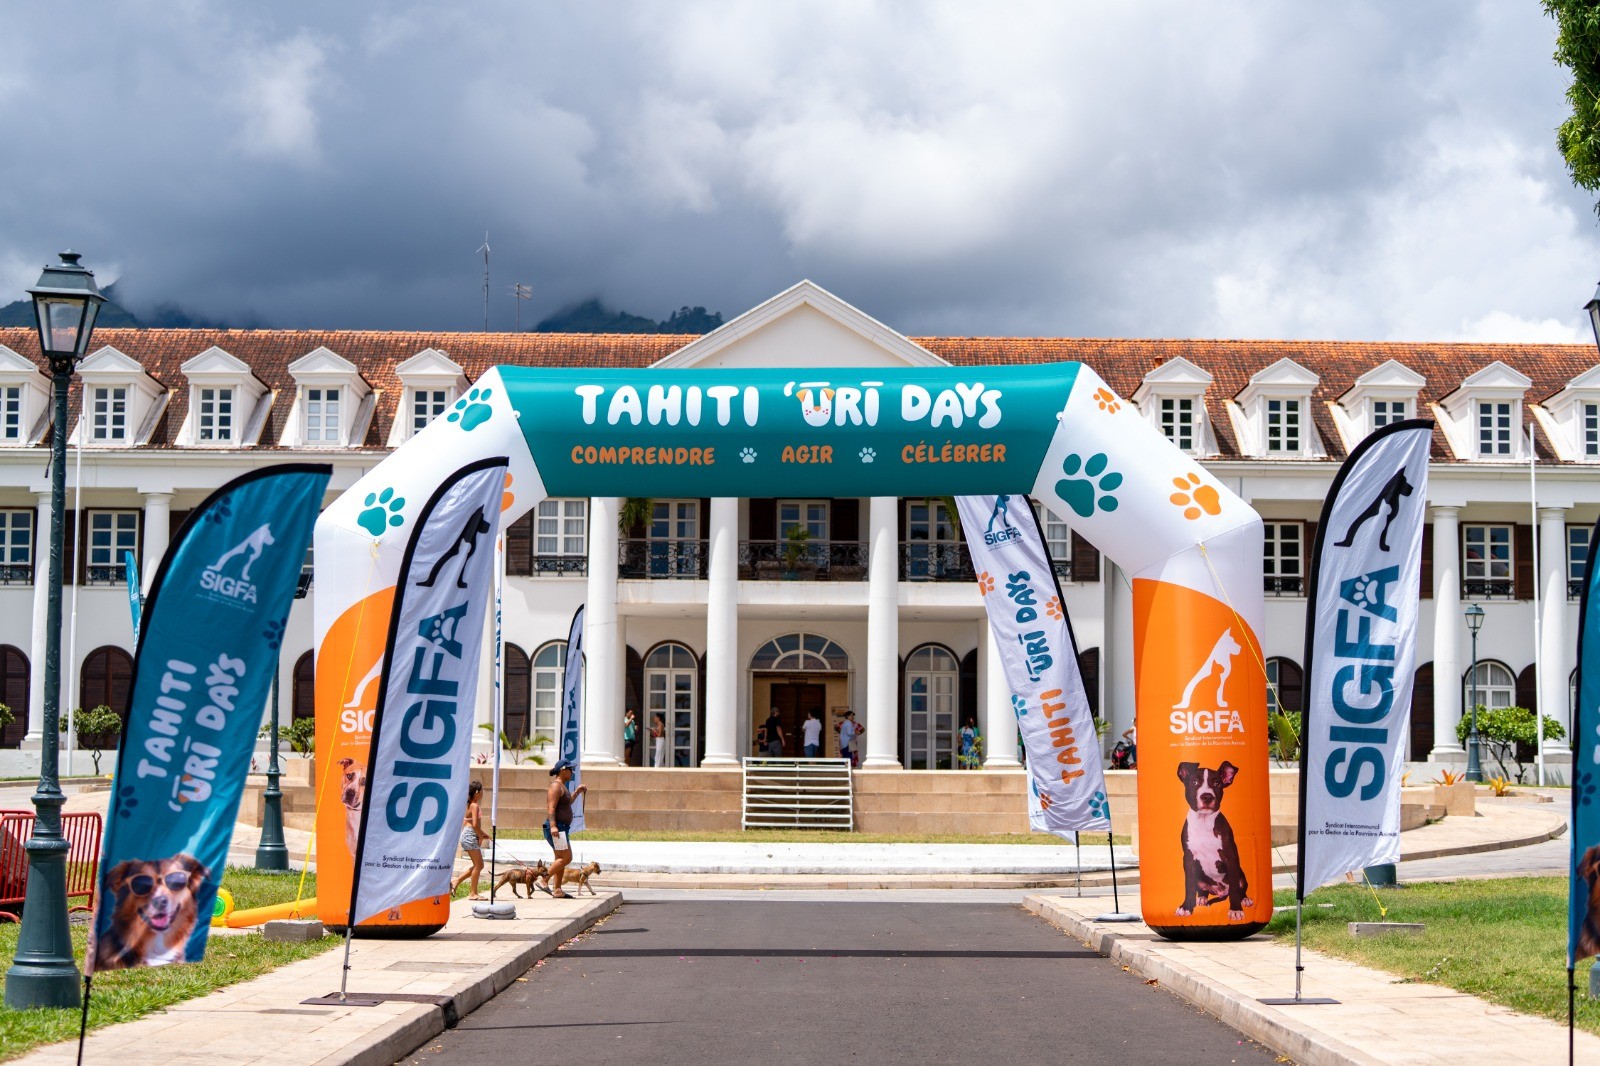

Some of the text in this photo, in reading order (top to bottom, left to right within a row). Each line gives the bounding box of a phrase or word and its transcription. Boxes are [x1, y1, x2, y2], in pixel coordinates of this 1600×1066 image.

[574, 384, 759, 427] TAHITI
[901, 382, 1003, 429] DAYS
[571, 440, 1007, 466] COMPRENDRE AGIR CÉLÉBRER
[984, 527, 1022, 546] SIGFA
[200, 570, 257, 604] SIGFA
[1005, 570, 1038, 624] DAYS
[195, 653, 246, 731] DAYS
[1324, 564, 1400, 801] SIGFA
[137, 659, 198, 779] TAHITI
[385, 600, 469, 836] SIGFA
[1039, 688, 1085, 784] TAHITI
[1169, 710, 1245, 734] SIGFA
